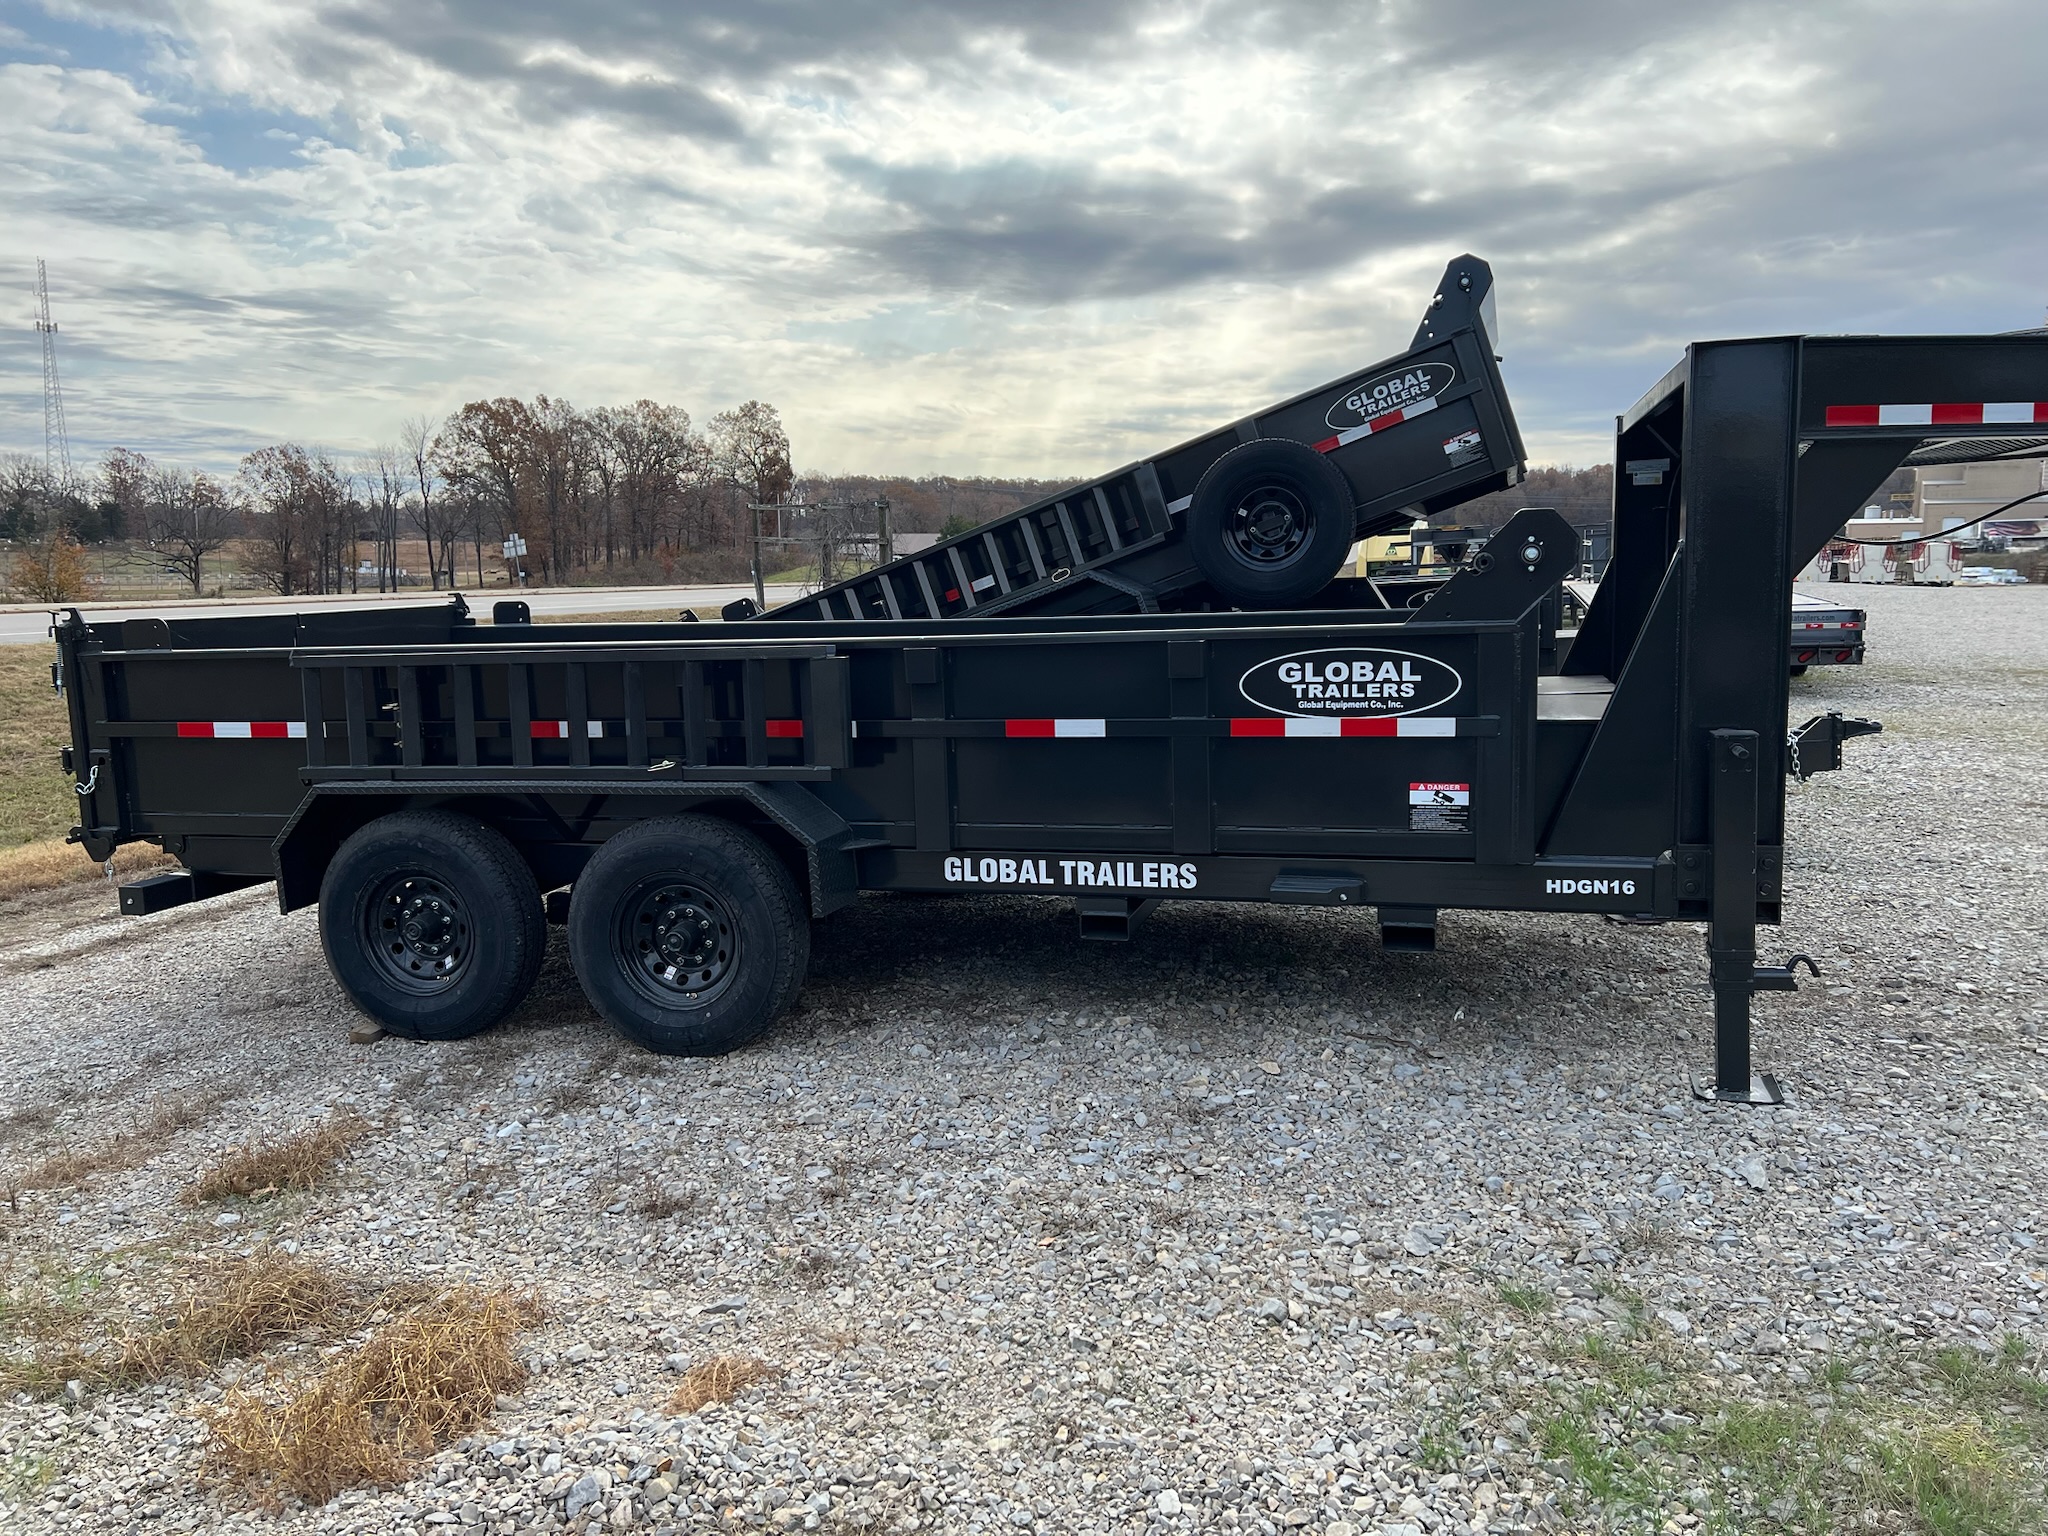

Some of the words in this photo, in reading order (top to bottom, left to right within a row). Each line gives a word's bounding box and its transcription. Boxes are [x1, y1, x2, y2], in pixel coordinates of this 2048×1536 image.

[1346, 369, 1431, 410] GLOBAL
[1357, 382, 1431, 416] TRAILERS
[1278, 661, 1421, 683] GLOBAL
[1291, 683, 1415, 698] TRAILERS
[1298, 701, 1324, 709] Global
[1325, 701, 1369, 710] Equipment
[1388, 700, 1404, 708] Inc.
[944, 856, 1054, 885] GLOBAL
[1059, 860, 1198, 889] TRAILERS
[1546, 879, 1636, 895] HDGN16
